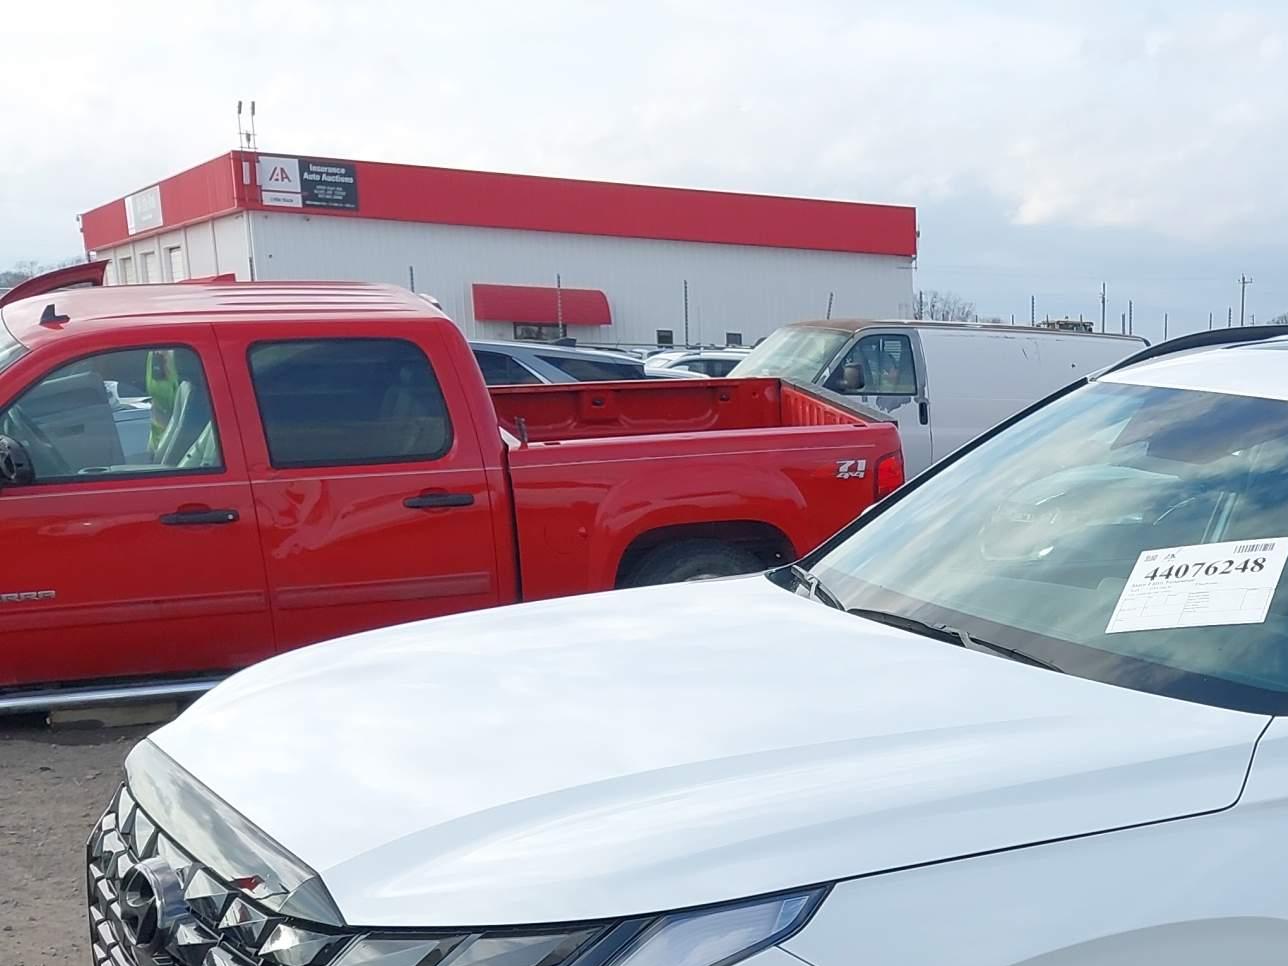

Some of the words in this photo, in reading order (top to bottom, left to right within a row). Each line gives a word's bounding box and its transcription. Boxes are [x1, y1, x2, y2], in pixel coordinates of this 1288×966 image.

[309, 163, 346, 175] Insurance
[302, 171, 321, 182] Auto
[321, 173, 355, 184] Auctions
[1144, 556, 1267, 581] 44076248
